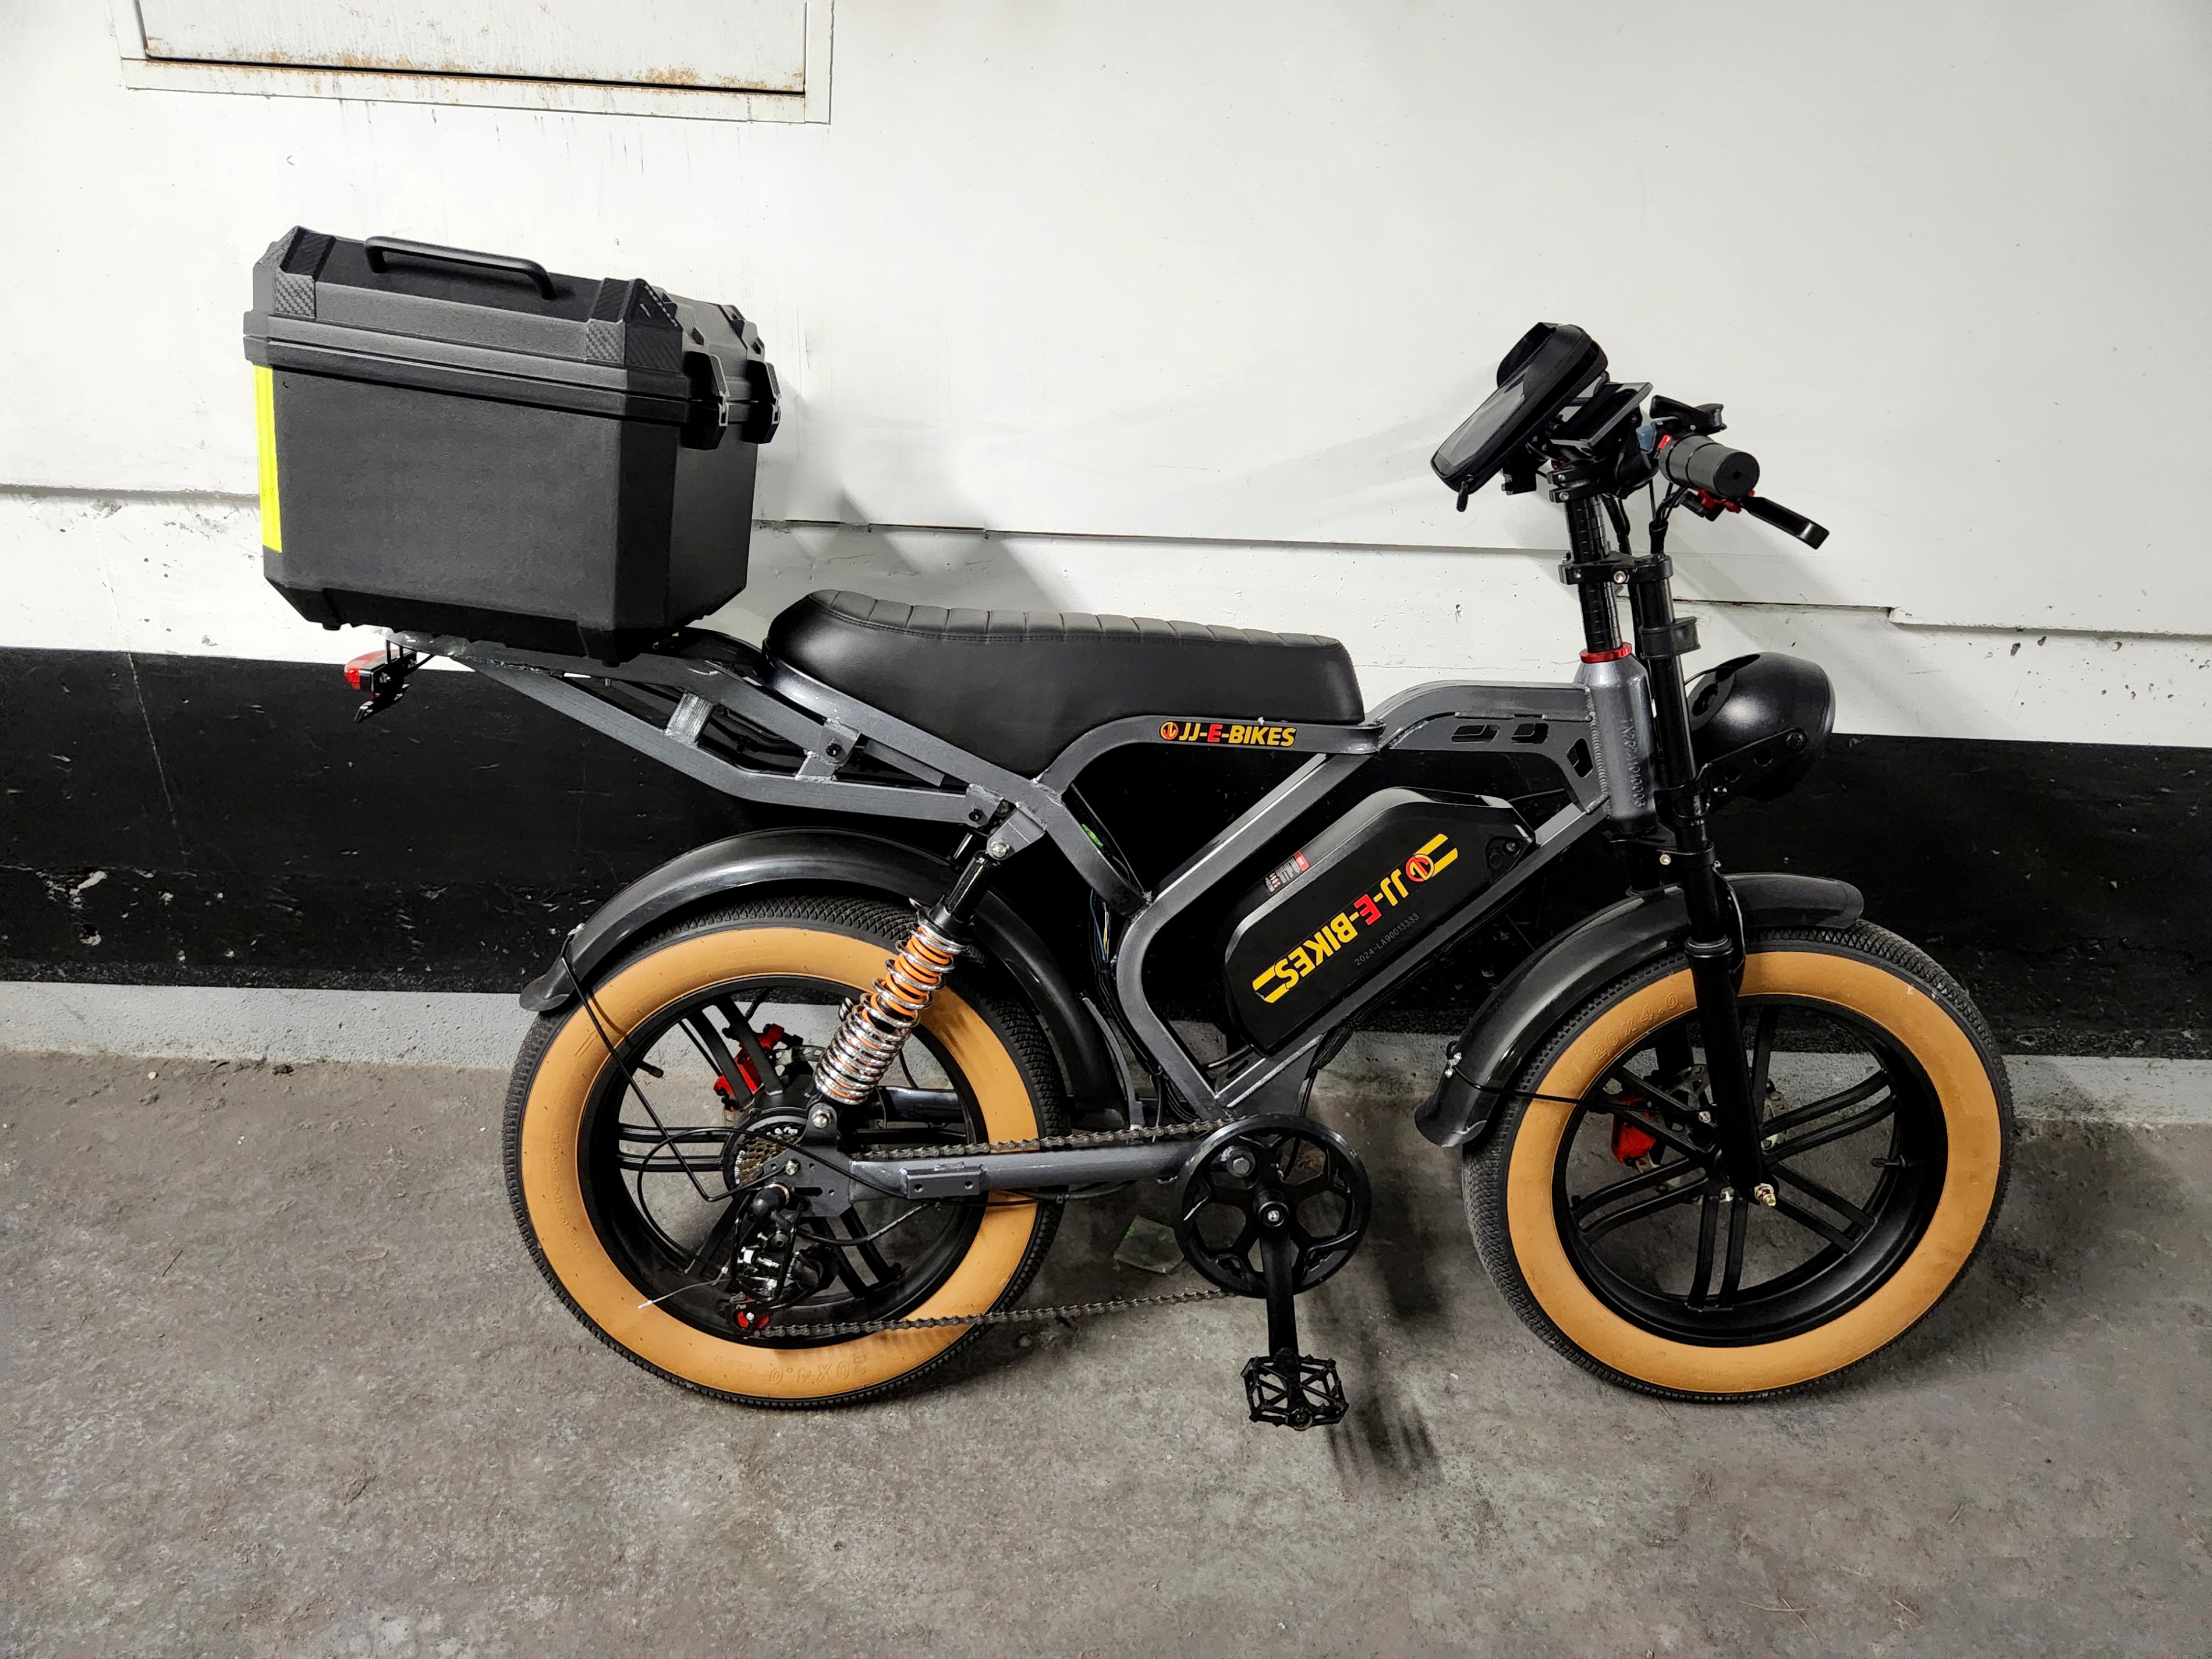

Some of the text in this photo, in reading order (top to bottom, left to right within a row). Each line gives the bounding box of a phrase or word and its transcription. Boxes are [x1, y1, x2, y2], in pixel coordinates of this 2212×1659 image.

[1179, 722, 1297, 747] JJ-E-BIKES
[1274, 869, 1409, 990] JJ-E-BIKES
[1354, 912, 1420, 966] 2024-LA90013333
